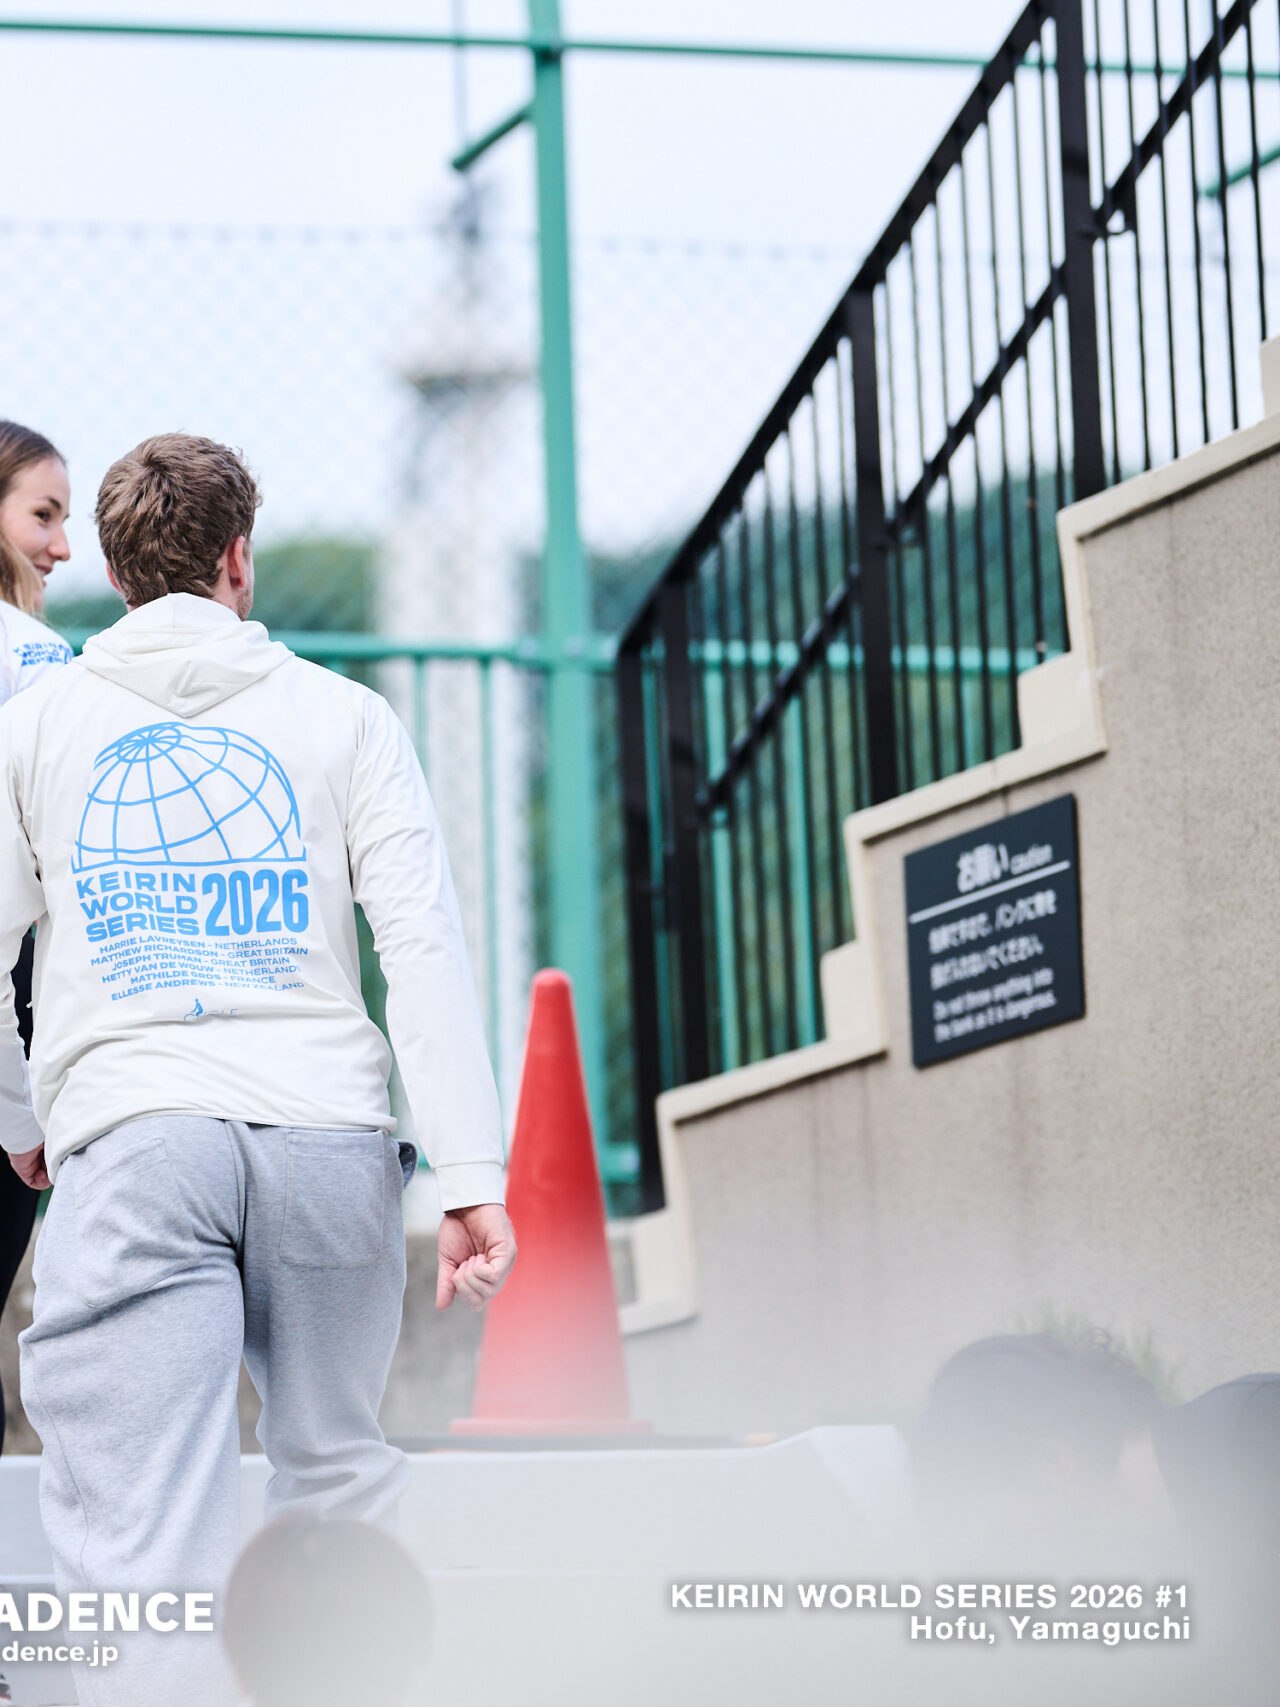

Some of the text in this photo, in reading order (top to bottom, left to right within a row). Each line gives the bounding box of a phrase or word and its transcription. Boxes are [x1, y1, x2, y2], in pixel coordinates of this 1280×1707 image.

[76, 868, 309, 937] KEIRIN 2026
[80, 892, 198, 920] WORLD
[85, 912, 200, 943] SERIES
[90, 946, 142, 967] MATTHEW
[144, 944, 218, 957] RICHARDSON
[227, 949, 262, 959] GREAT
[265, 947, 308, 956] BRITAIN
[100, 937, 137, 954] HARRIE
[139, 935, 205, 948] LAVREYSEN
[214, 937, 297, 950] NETHERLANDS
[101, 967, 132, 984] HETTY
[134, 962, 158, 973] VAN
[159, 961, 176, 969] DE
[178, 961, 214, 973] WOUW
[112, 954, 151, 971] JOSEPH
[153, 952, 202, 964] TRUMAN
[210, 958, 247, 968] GREAT
[249, 956, 290, 967] BRITAIN
[130, 970, 189, 985] MATHILDE
[190, 971, 221, 980] GROS
[230, 975, 276, 985] FRANCE
[111, 983, 153, 1002] ELLESSE
[155, 978, 216, 990] ANDREWS
